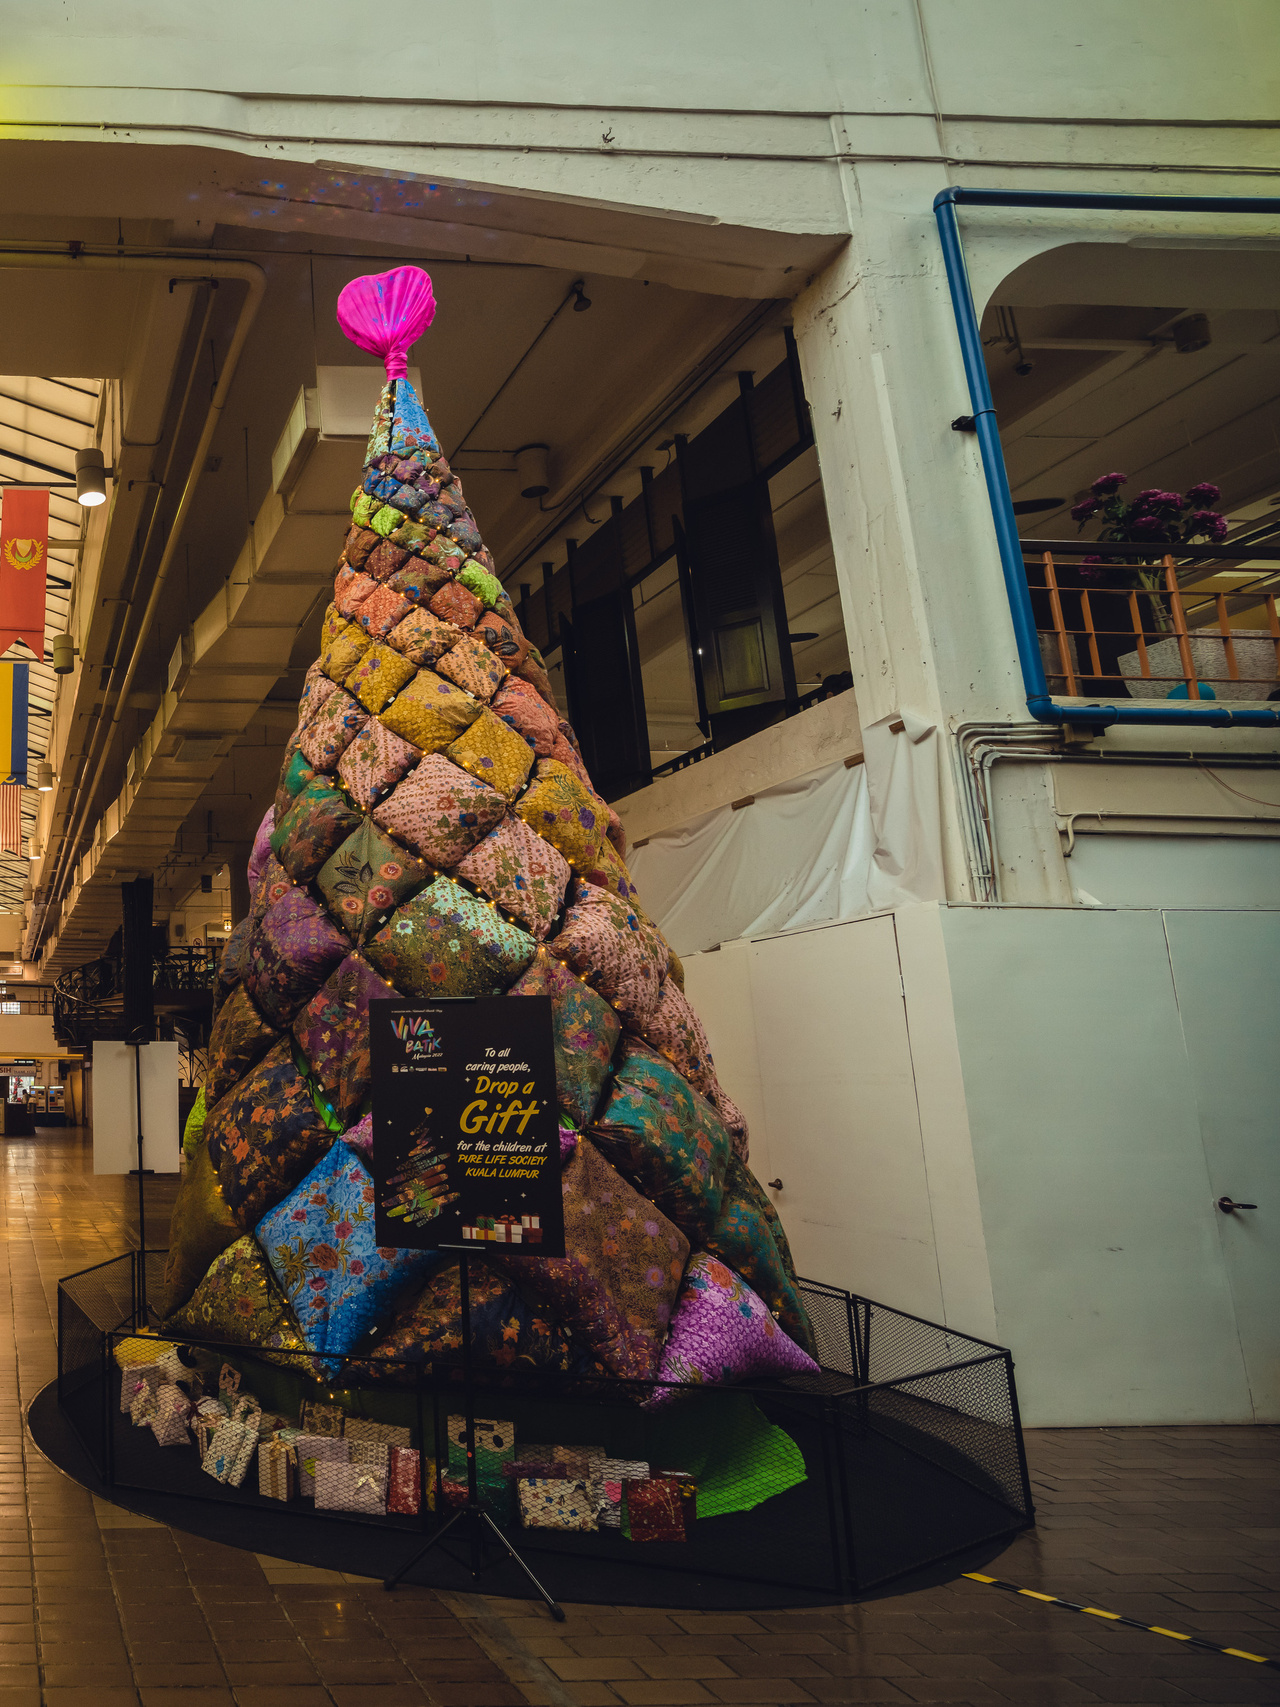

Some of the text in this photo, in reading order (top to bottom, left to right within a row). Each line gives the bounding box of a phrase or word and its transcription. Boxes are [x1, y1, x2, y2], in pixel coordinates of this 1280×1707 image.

[405, 1037, 442, 1054] BATIK
[485, 1047, 511, 1058] To all
[465, 1061, 531, 1074] caring people,
[475, 1075, 535, 1099] Drop a
[459, 1099, 540, 1136] Gift
[457, 1140, 548, 1153] for the children at
[457, 1154, 548, 1165] PURE LIFE SOCIETY
[465, 1167, 540, 1179] KUALA LUMPUR
